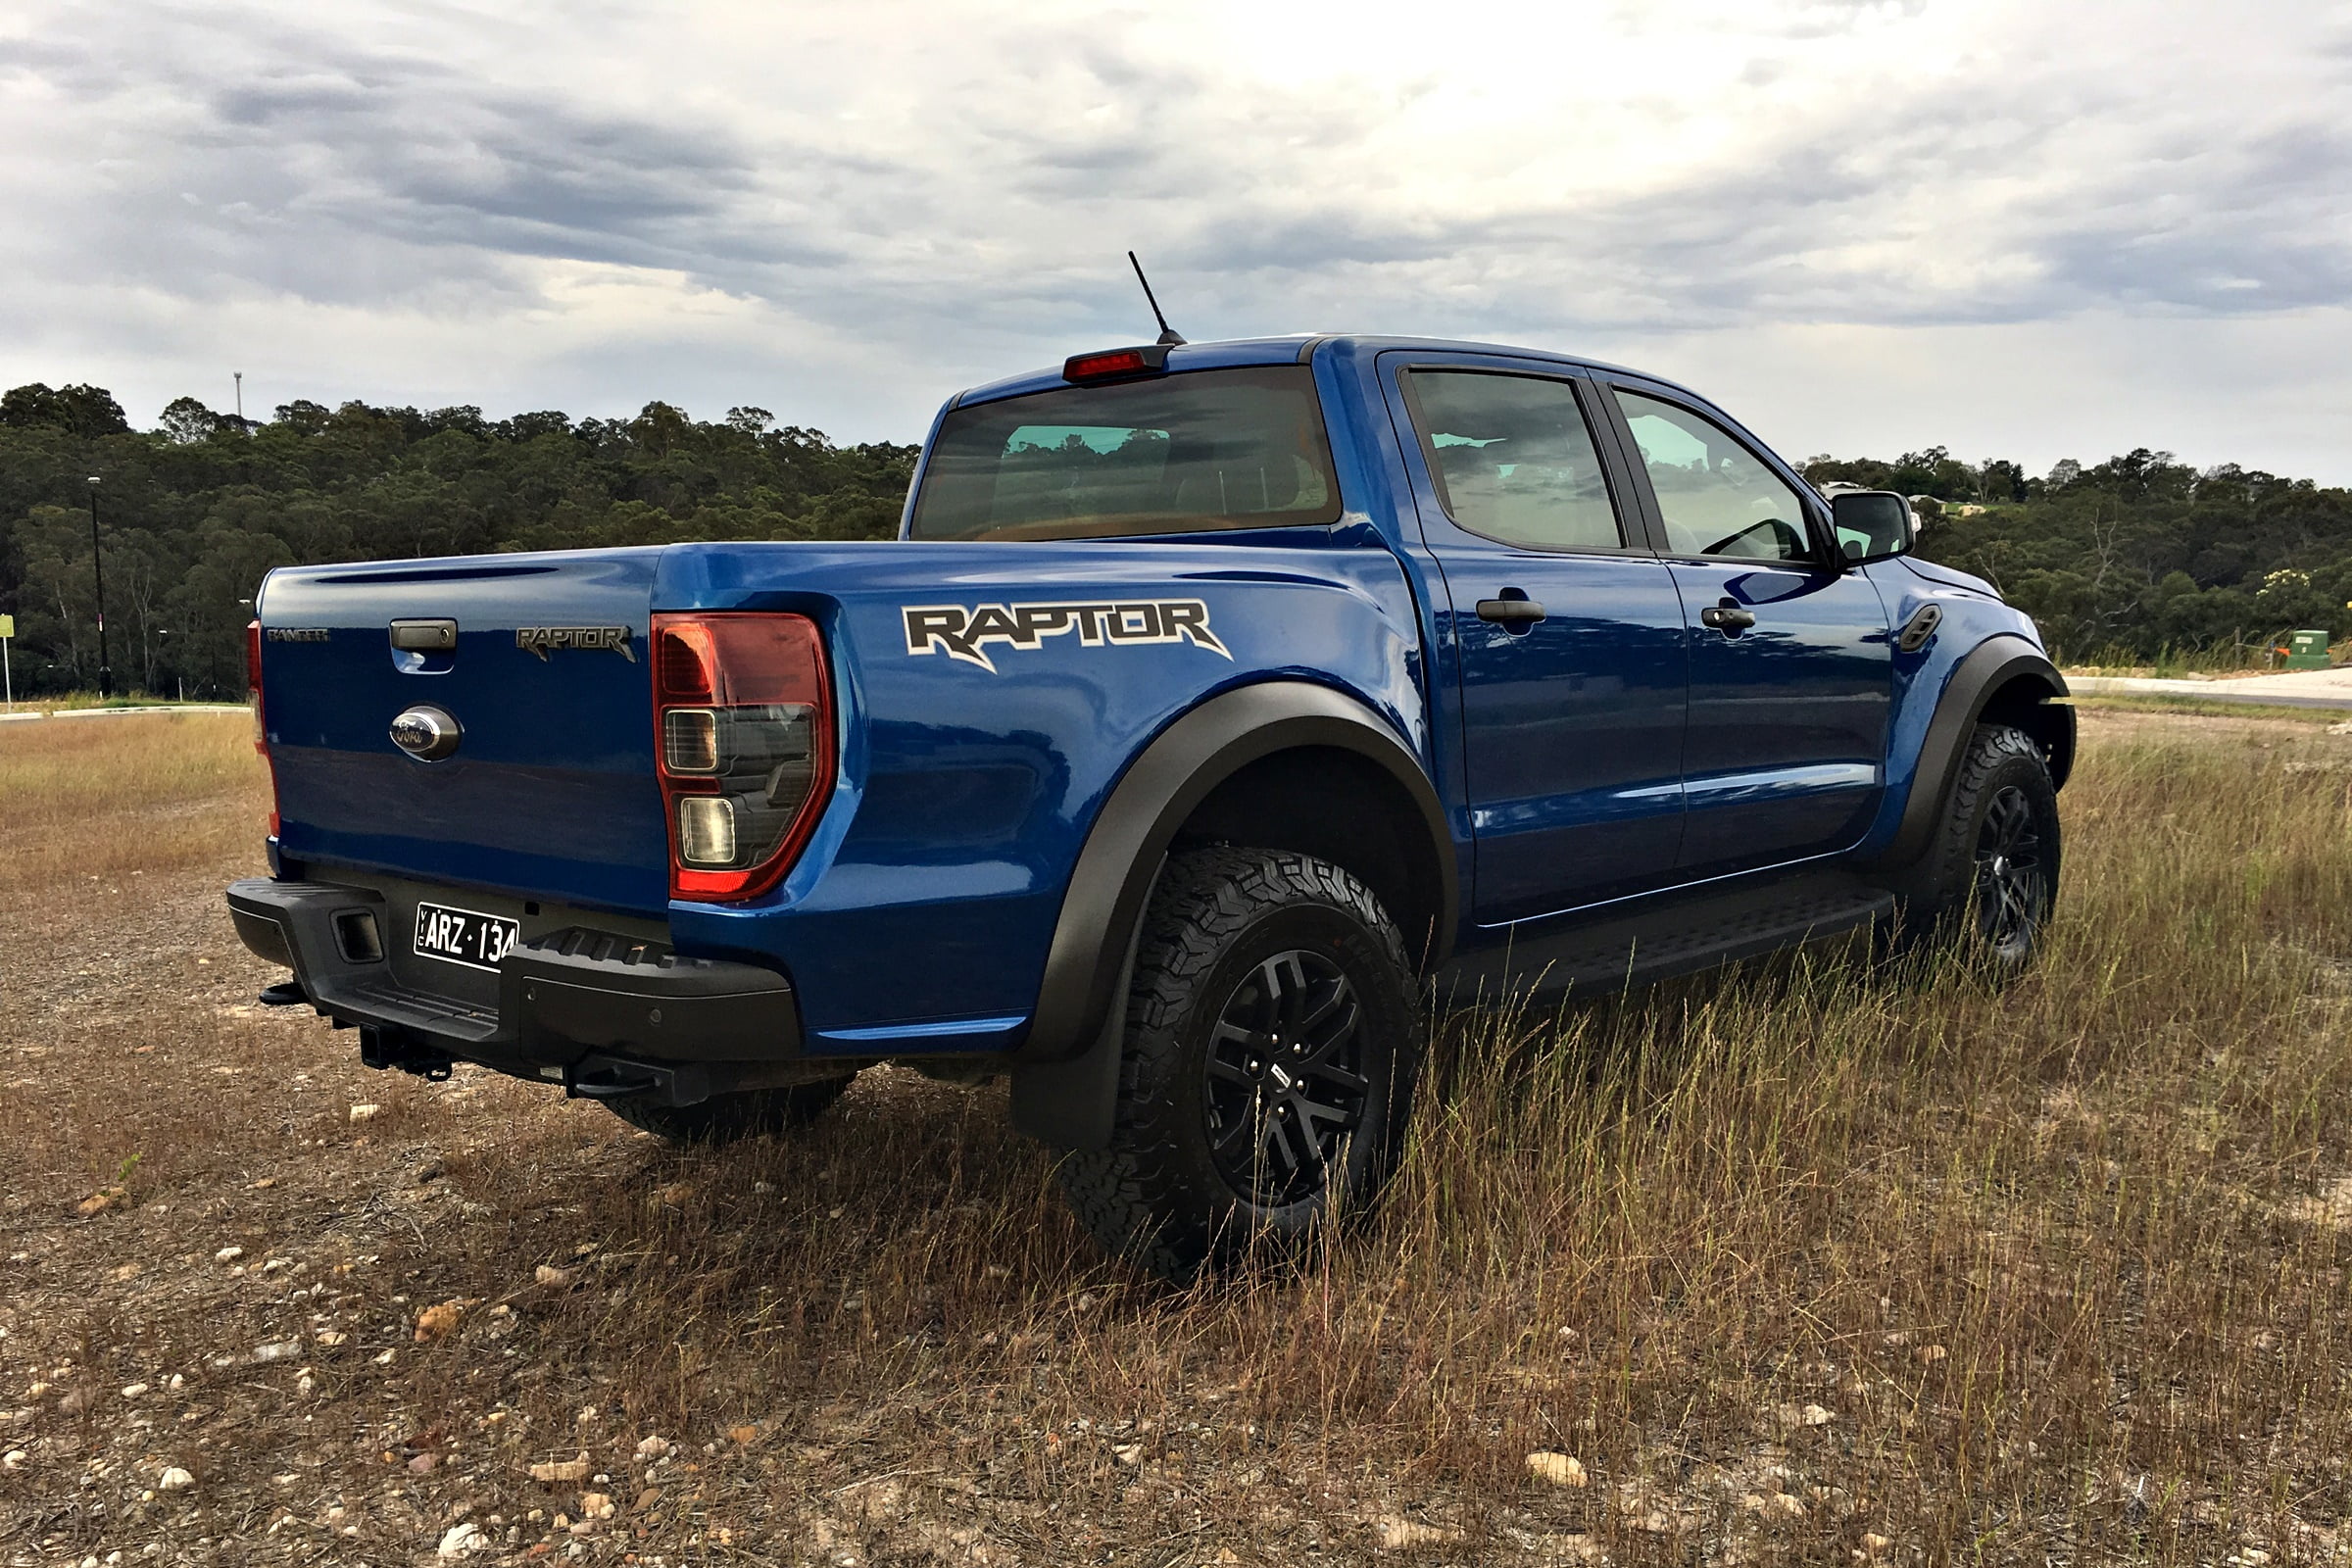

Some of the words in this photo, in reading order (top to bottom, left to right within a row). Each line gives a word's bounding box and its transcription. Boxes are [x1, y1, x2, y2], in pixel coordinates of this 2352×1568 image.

[515, 626, 636, 663] RAPTOR
[901, 598, 1236, 674] RAPTOR
[417, 909, 427, 947] VIC
